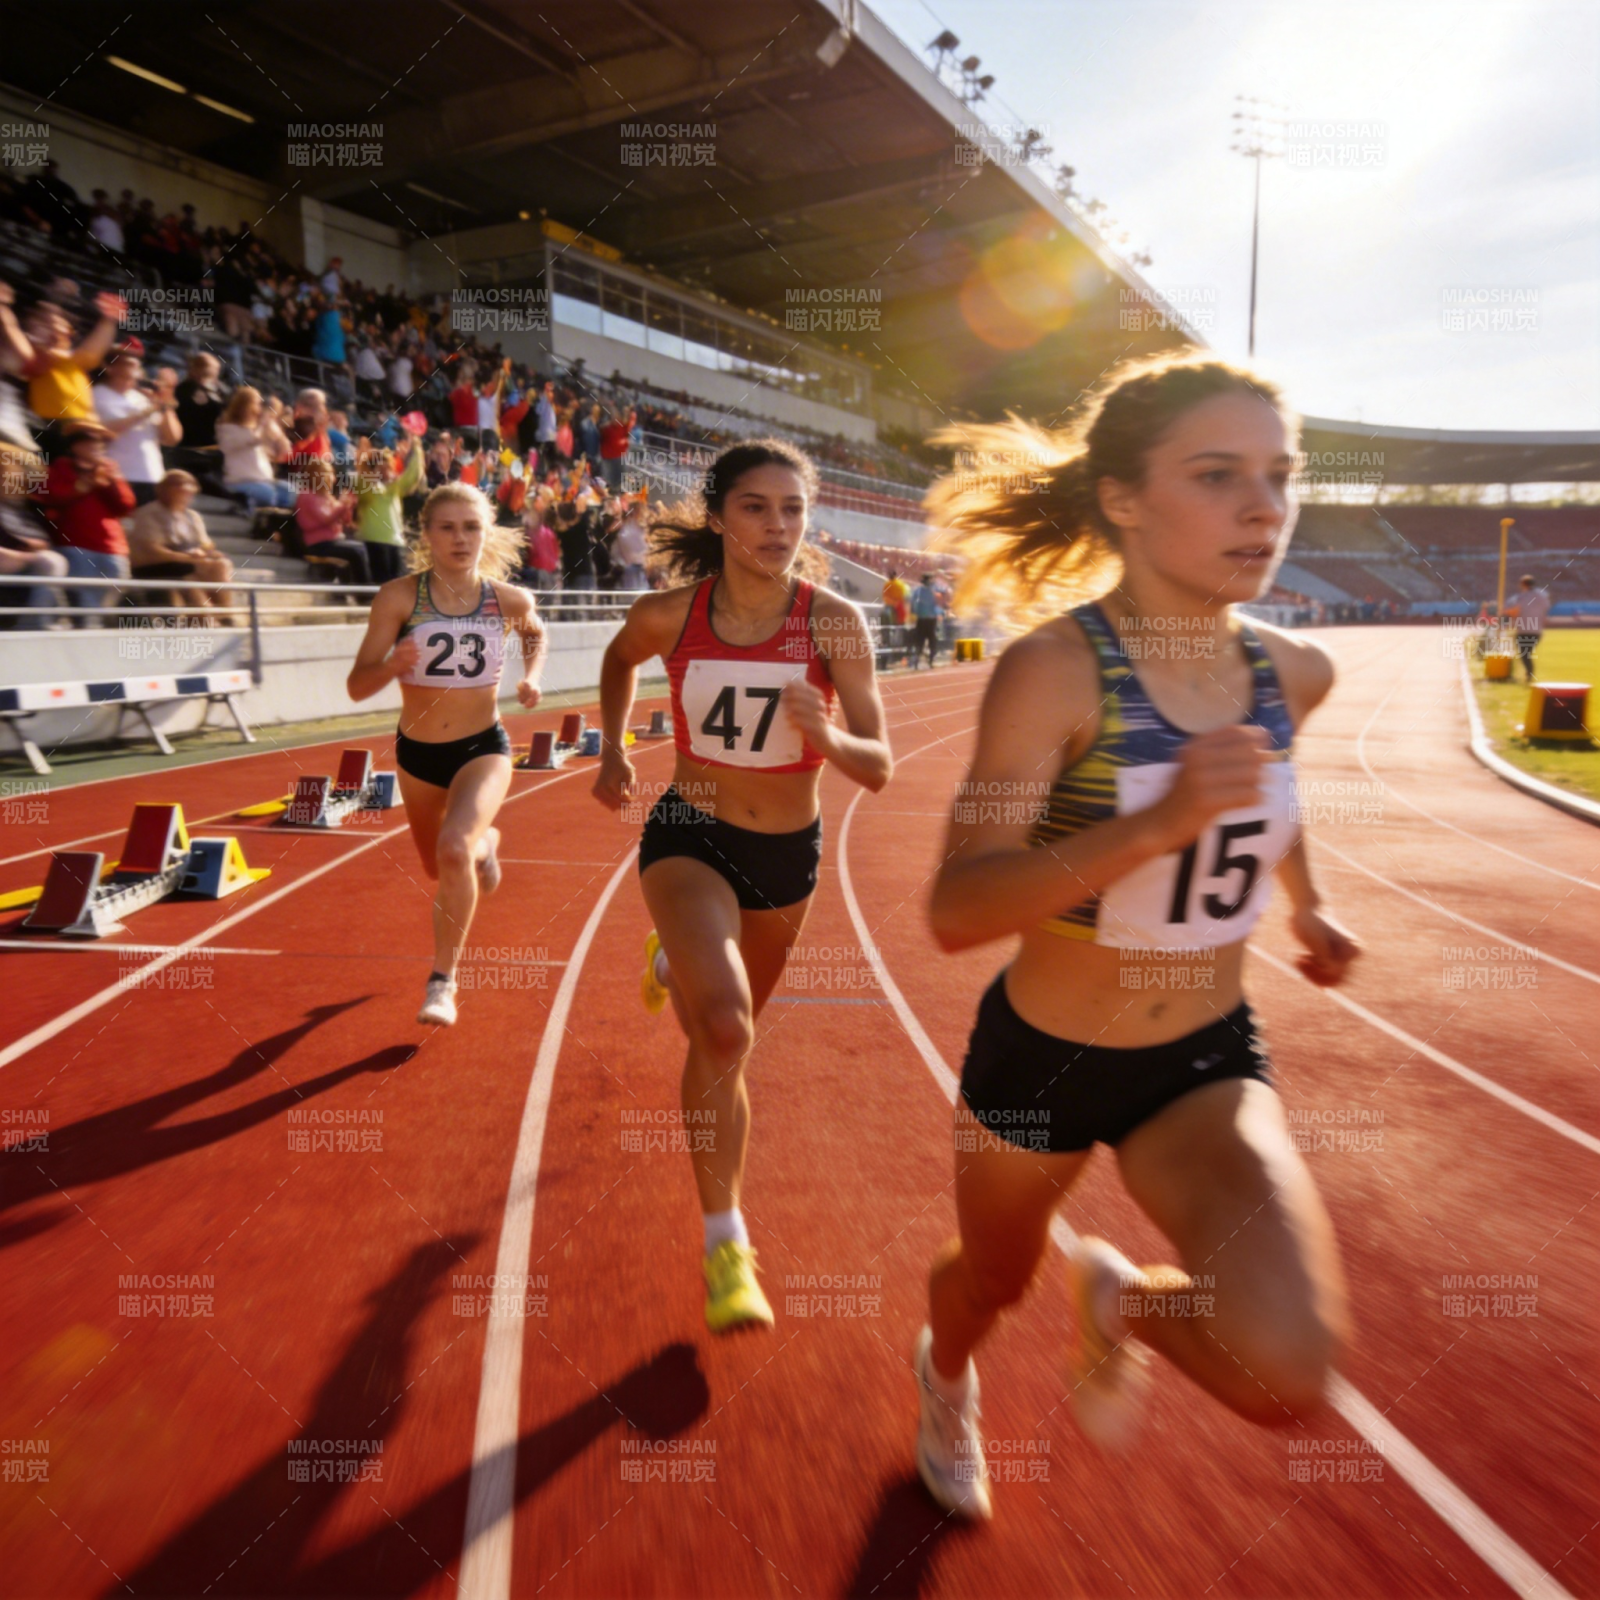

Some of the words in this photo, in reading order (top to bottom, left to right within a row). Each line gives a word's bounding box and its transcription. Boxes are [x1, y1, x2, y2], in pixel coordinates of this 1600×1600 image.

[424, 631, 487, 678] 23
[701, 685, 784, 752] 47
[1166, 819, 1268, 924] 15
